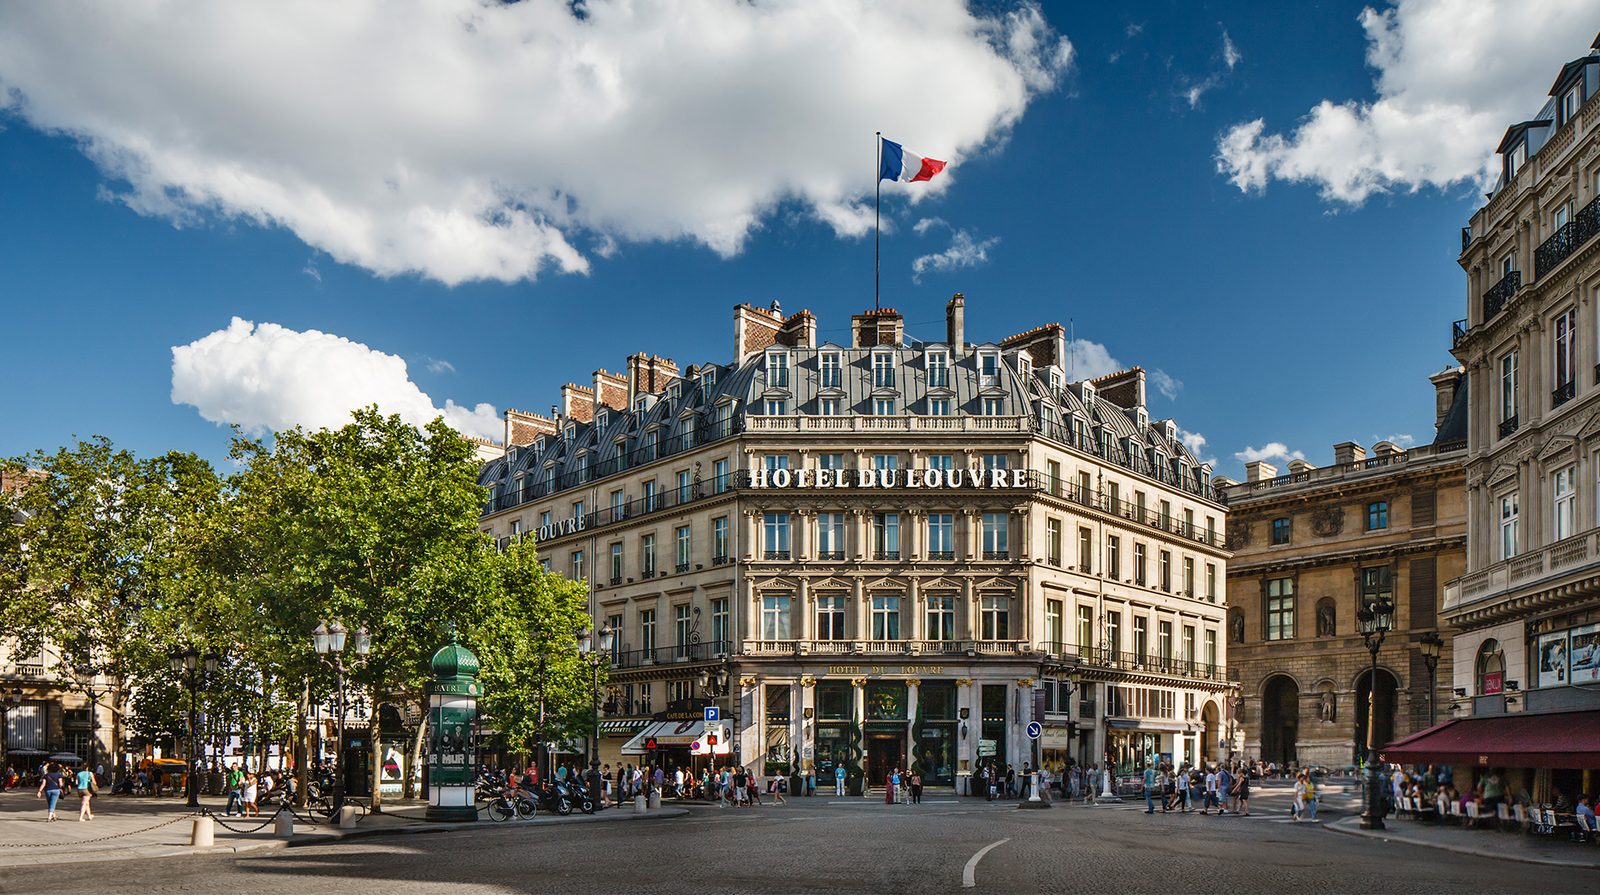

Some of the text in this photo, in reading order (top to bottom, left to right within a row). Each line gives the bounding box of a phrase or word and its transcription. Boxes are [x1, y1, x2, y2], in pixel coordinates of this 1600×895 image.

[750, 468, 1029, 488] HOTEL DU LOUVRE
[709, 710, 716, 719] P
